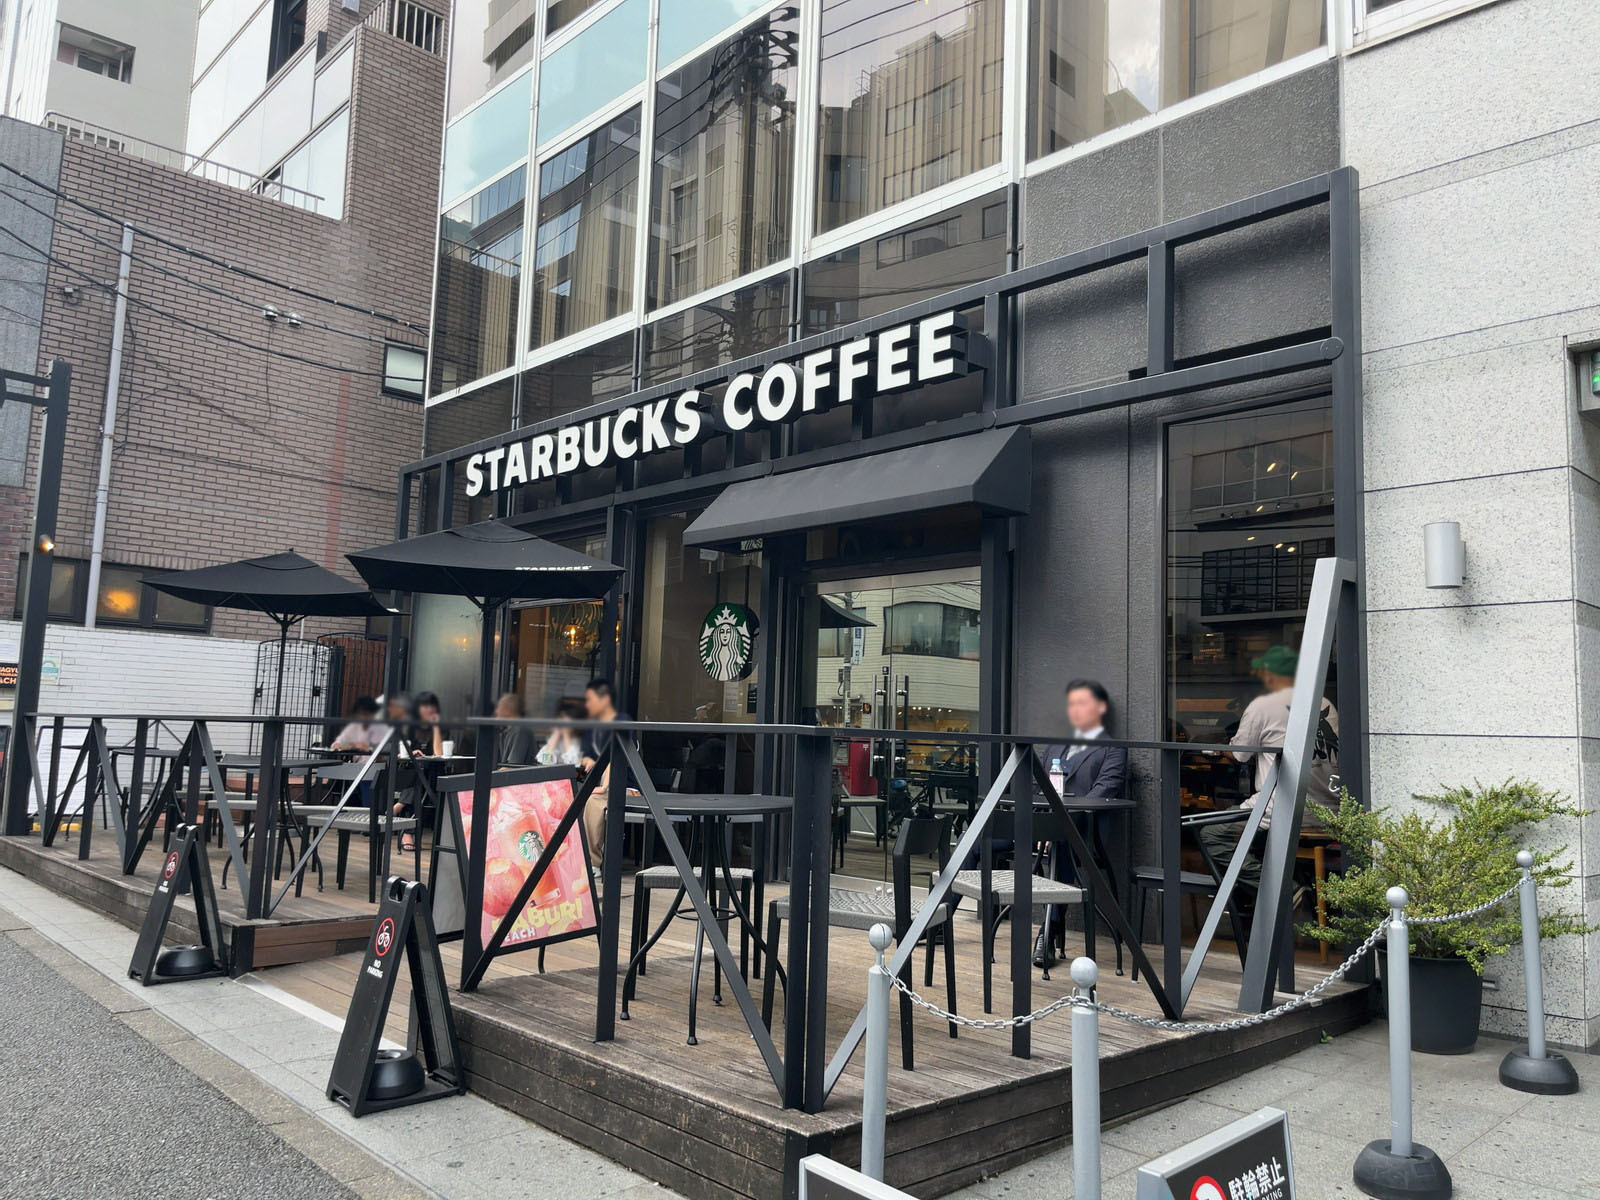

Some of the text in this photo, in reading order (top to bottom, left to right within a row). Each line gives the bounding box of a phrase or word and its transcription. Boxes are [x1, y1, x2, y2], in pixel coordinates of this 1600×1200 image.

[466, 311, 956, 497] STARBUCKS COFFEE
[491, 898, 583, 933] ABURI
[504, 927, 536, 942] EACH
[1228, 1156, 1286, 1200] 駐輪禁止
